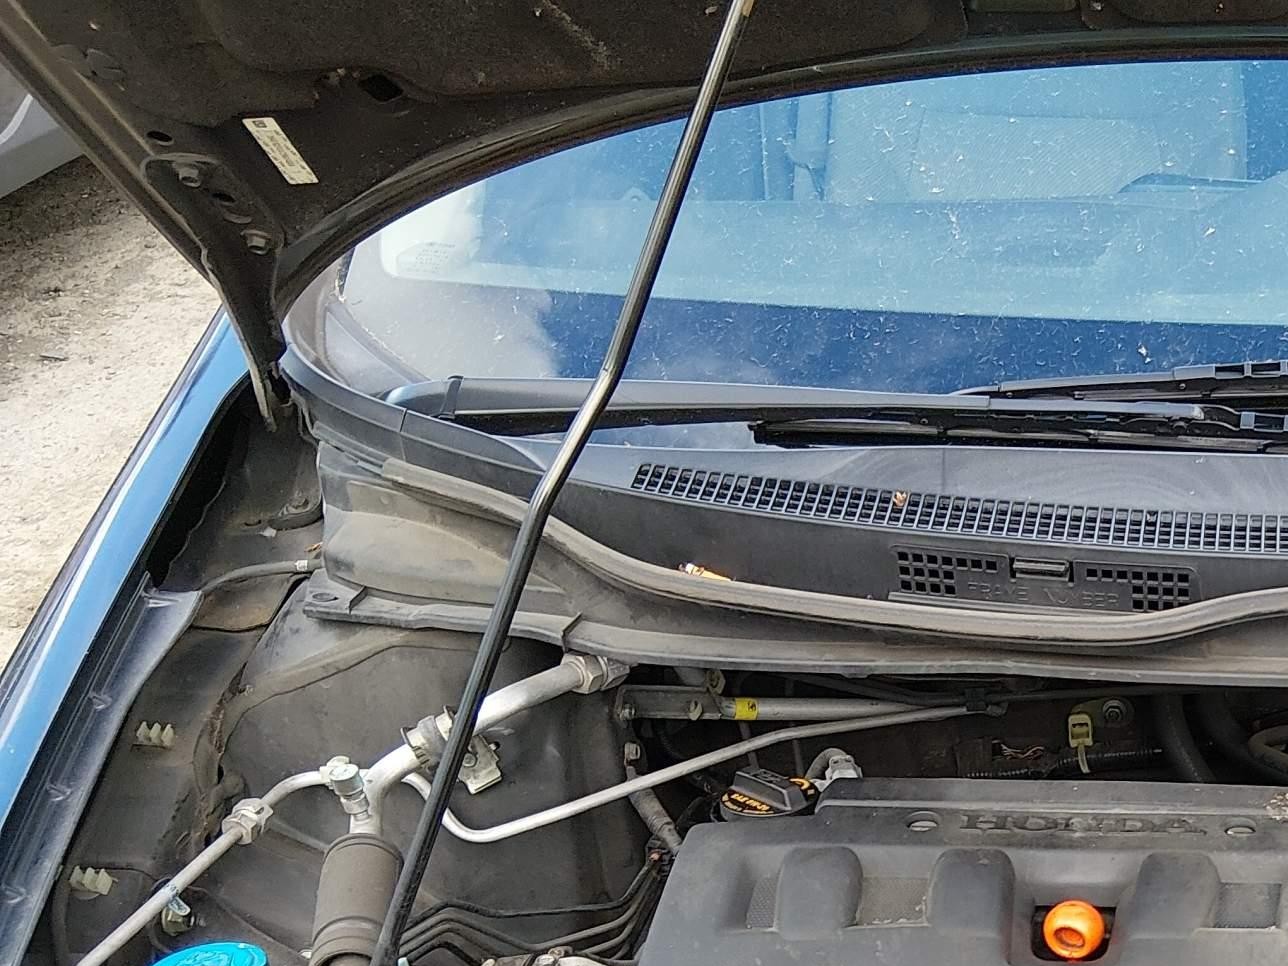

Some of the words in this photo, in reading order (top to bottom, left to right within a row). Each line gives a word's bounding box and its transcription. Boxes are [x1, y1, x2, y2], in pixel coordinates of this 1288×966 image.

[967, 582, 1029, 601] FRAME
[1043, 586, 1121, 608] NUMBER
[959, 811, 1208, 836] HONDA
